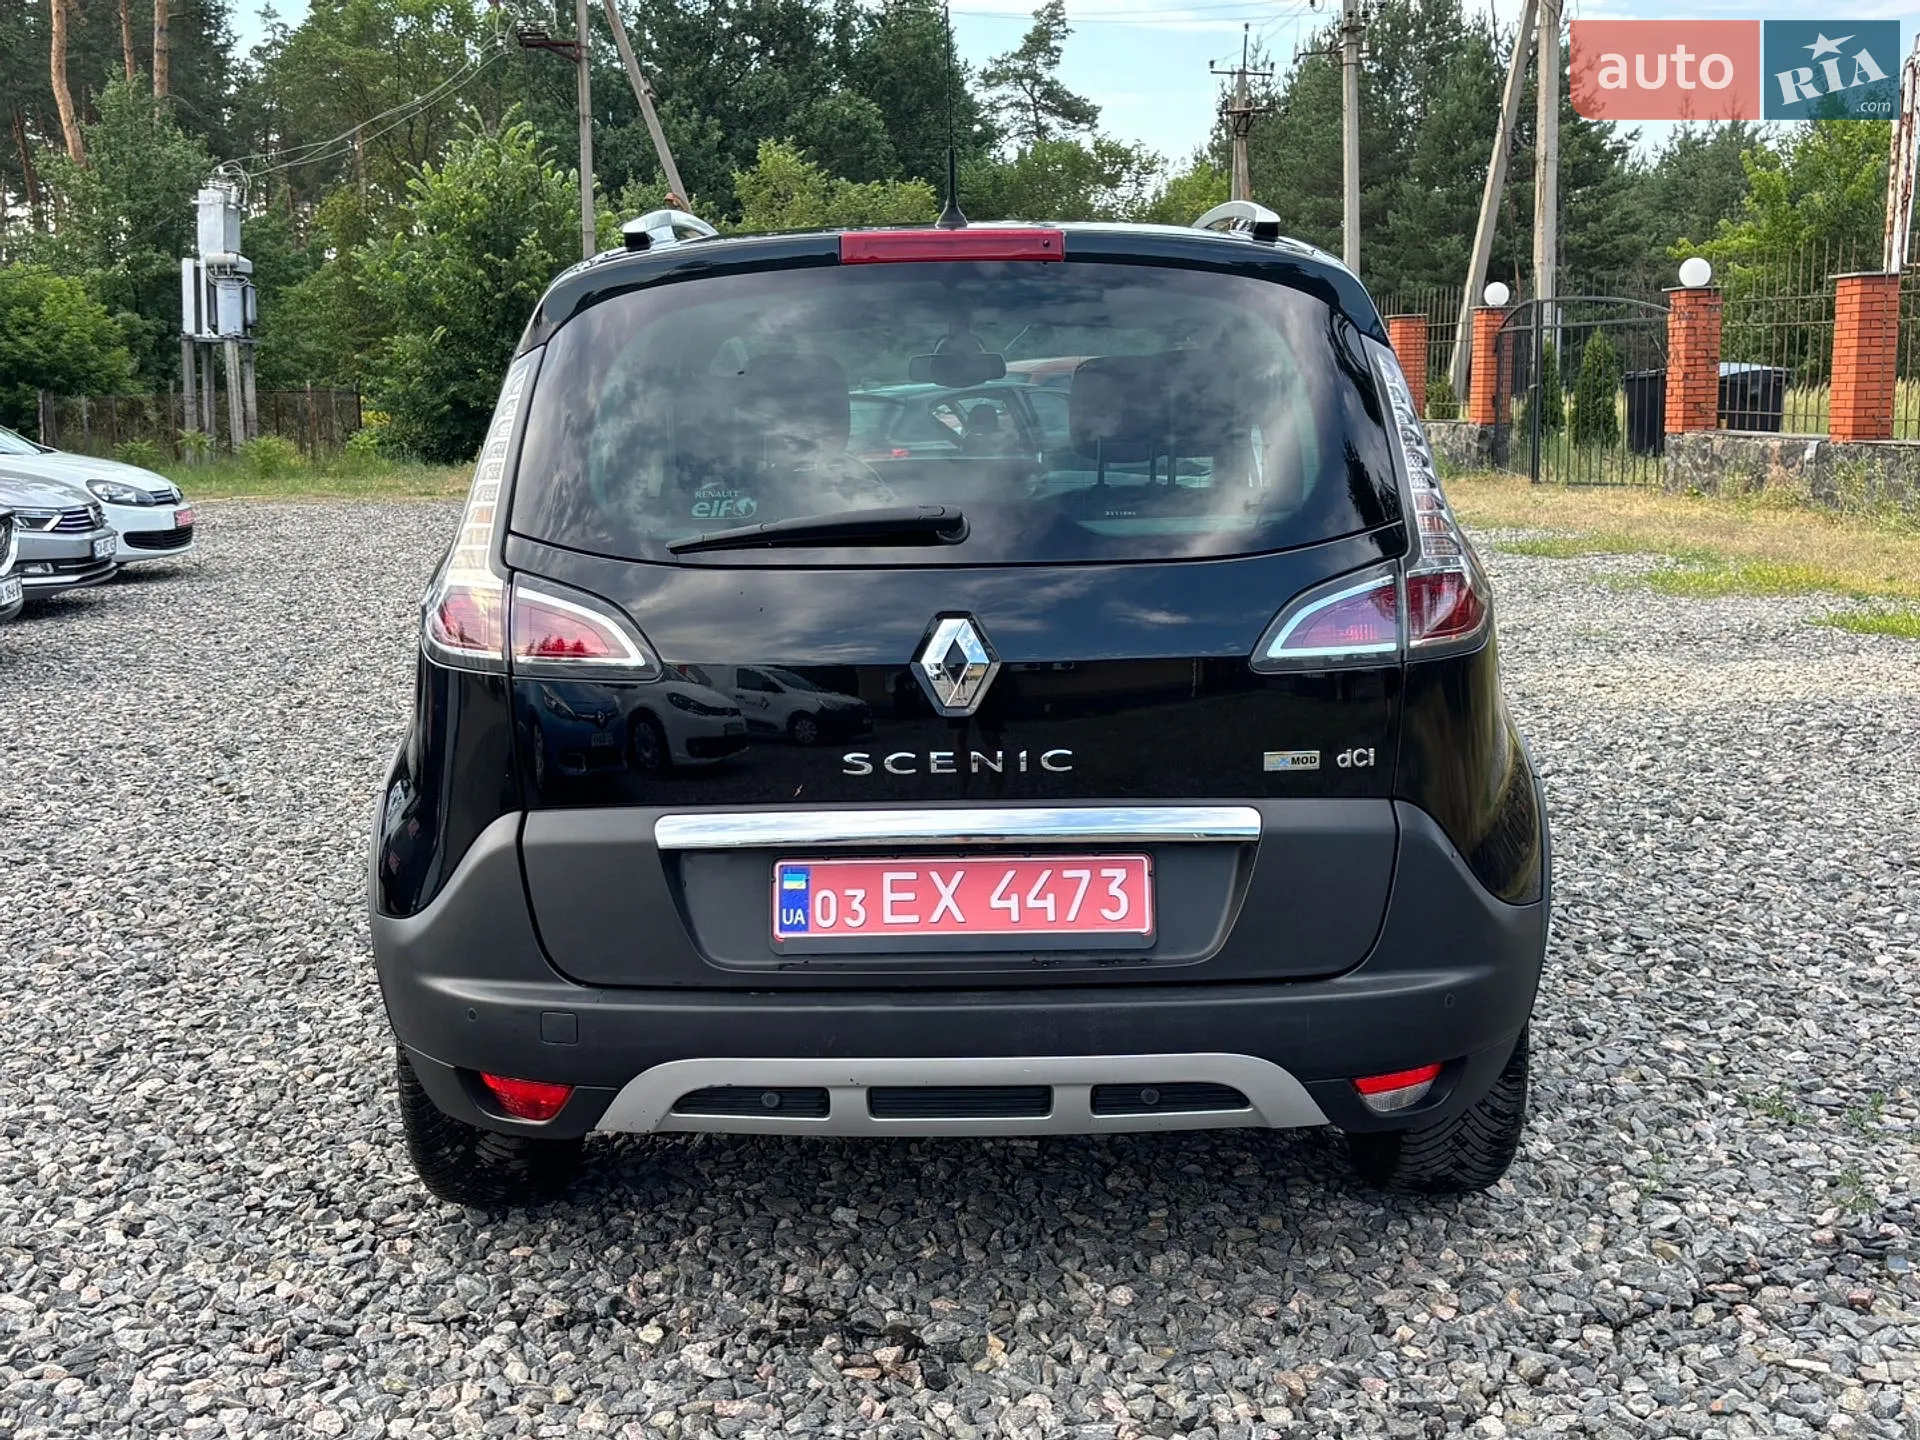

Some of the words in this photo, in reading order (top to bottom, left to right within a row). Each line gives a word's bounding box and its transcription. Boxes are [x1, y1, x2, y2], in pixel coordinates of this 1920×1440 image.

[695, 490, 740, 498] RENAULT
[691, 500, 733, 517] elf
[842, 749, 1073, 775] SCENIC
[814, 889, 867, 928] 03
[882, 870, 966, 924] EX
[989, 868, 1130, 923] 4473
[782, 908, 805, 925] UA
